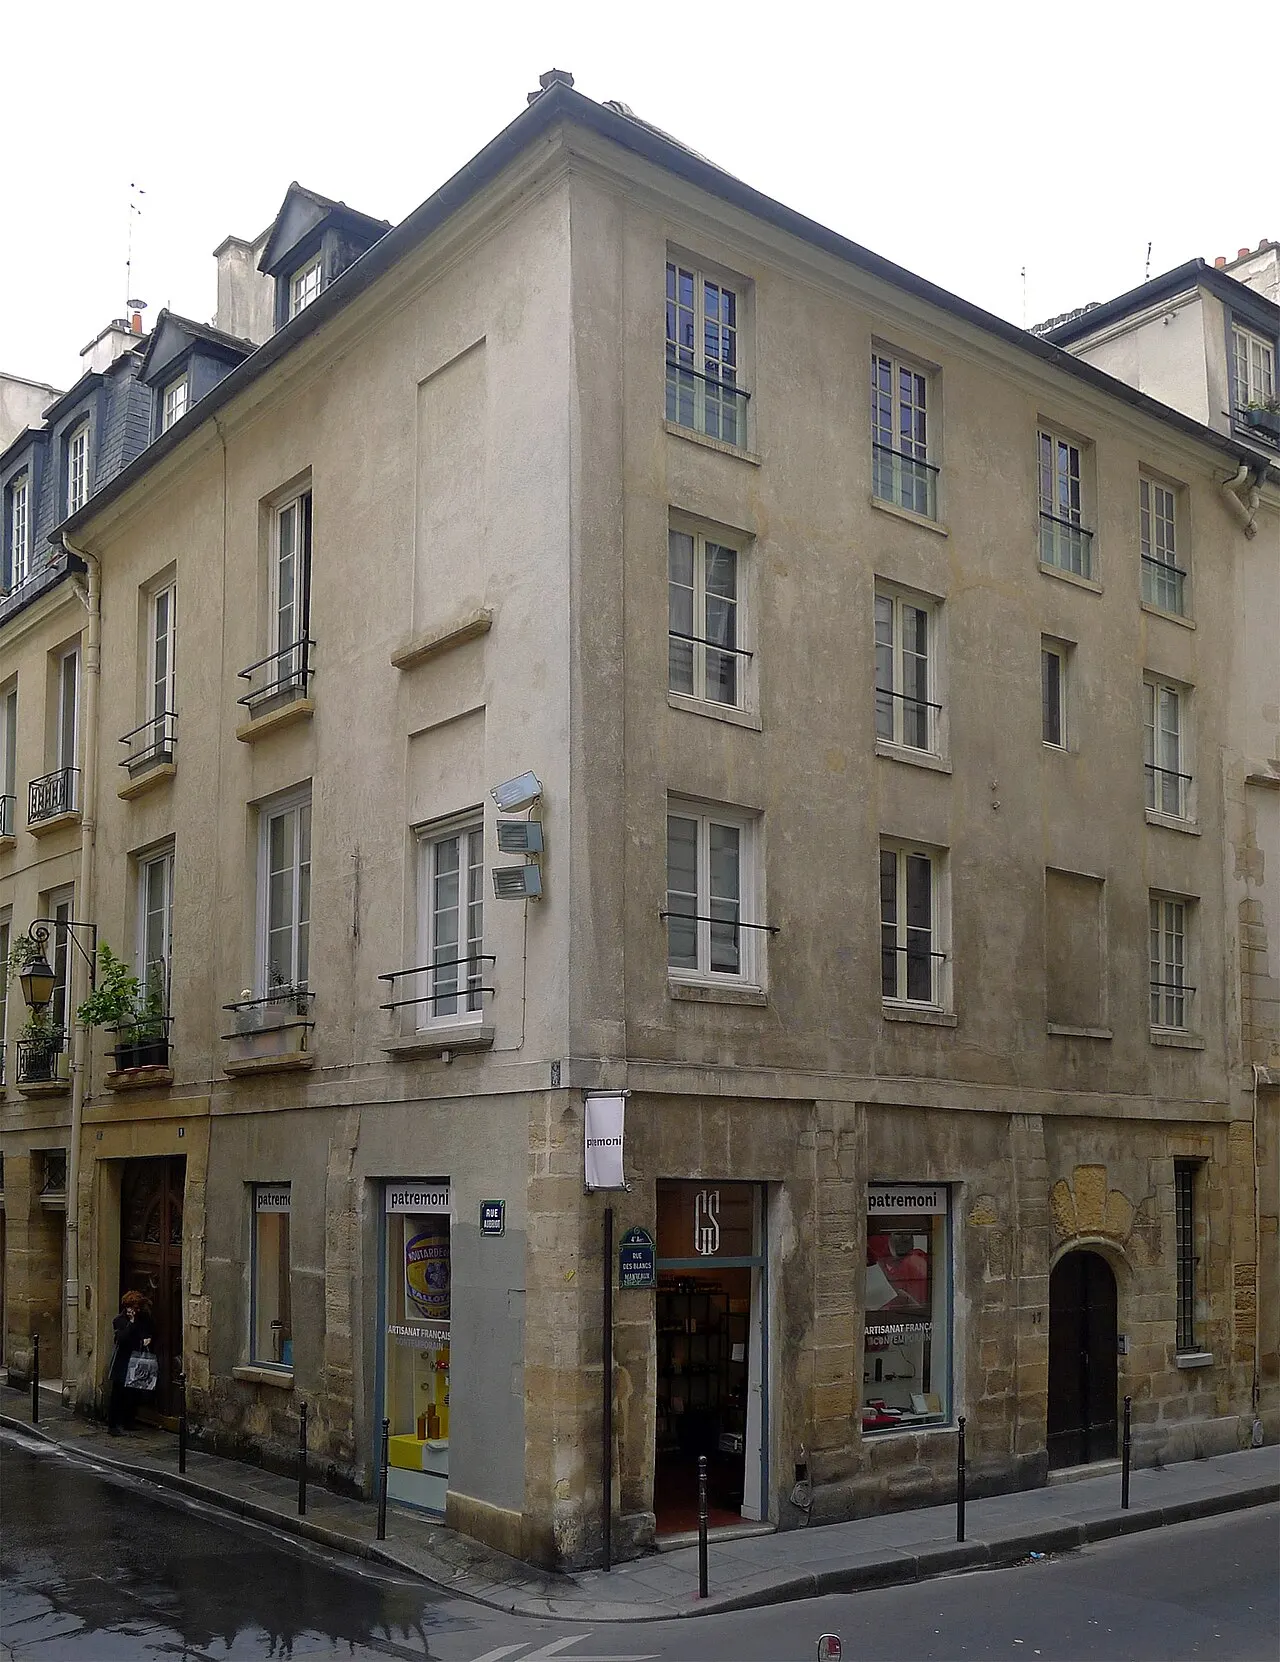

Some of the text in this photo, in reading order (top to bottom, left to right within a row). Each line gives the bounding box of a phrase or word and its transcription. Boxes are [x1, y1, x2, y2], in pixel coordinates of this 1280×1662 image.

[391, 1188, 449, 1209] patremoni
[868, 1191, 937, 1211] patremoni
[485, 1208, 499, 1218] RUE
[632, 1252, 643, 1260] RUE
[387, 1324, 451, 1341] ARTISANAT FRANÇAIS
[864, 1323, 905, 1335] ARTISANAT
